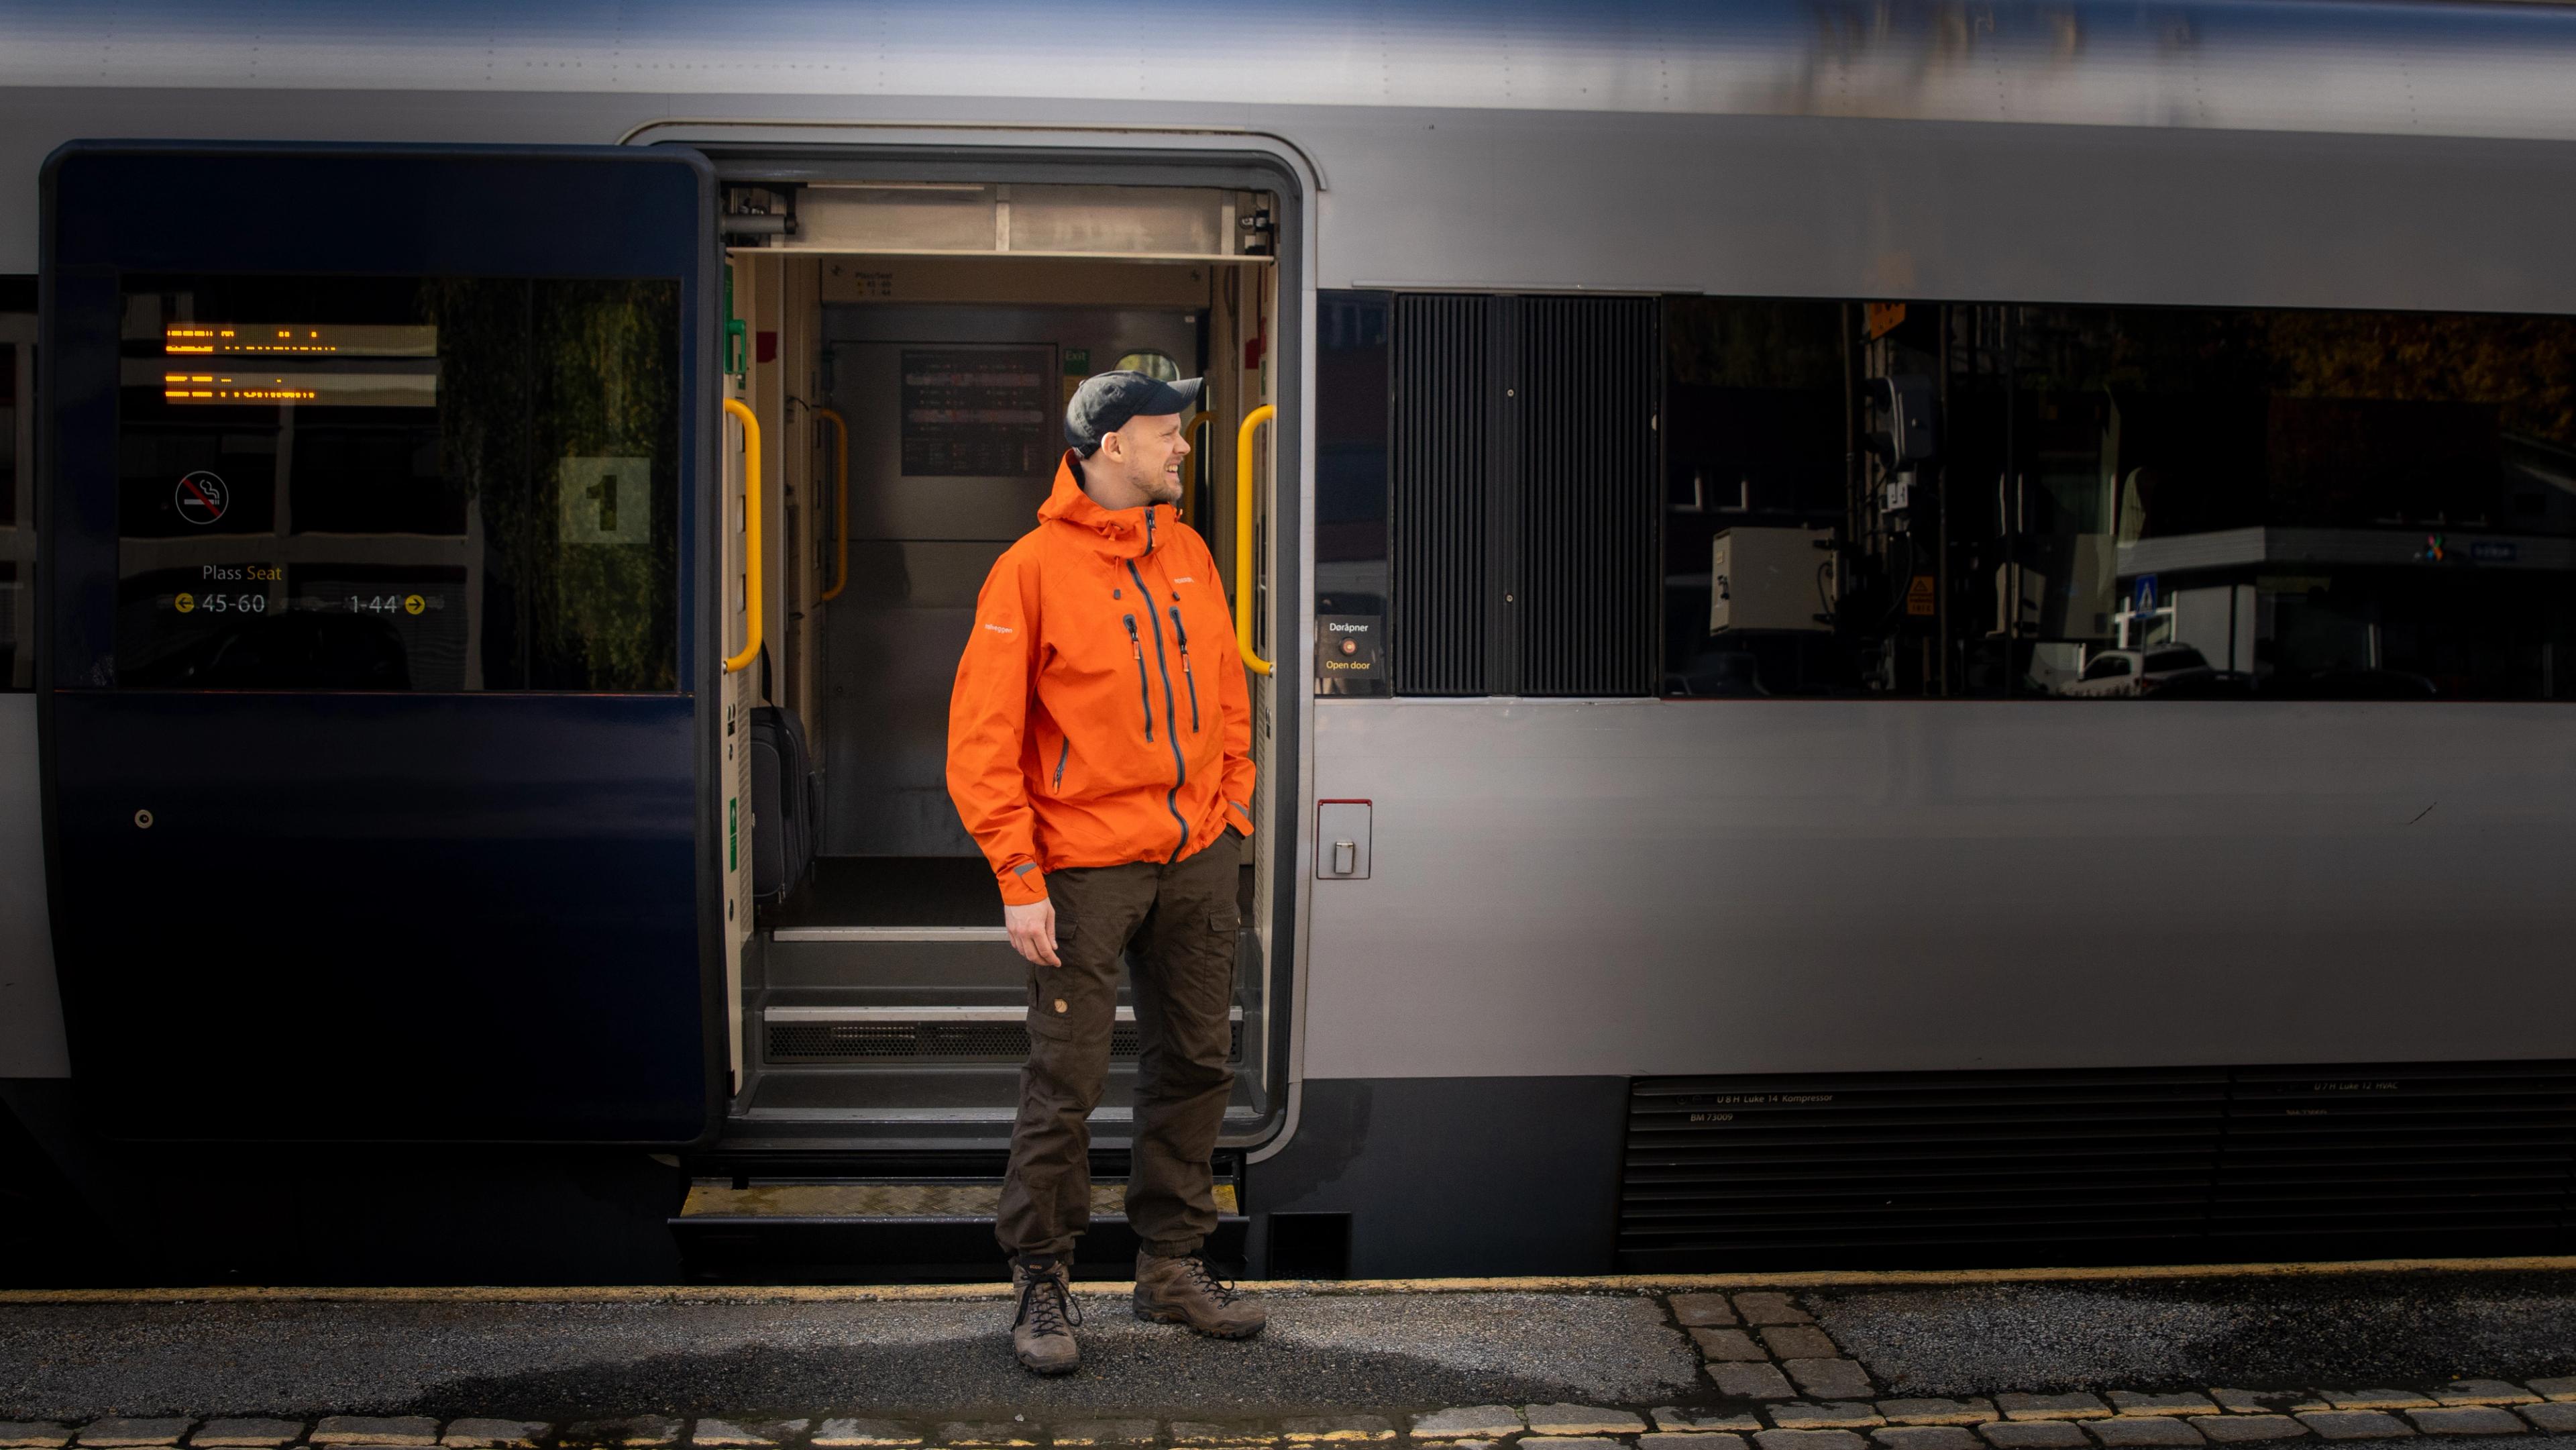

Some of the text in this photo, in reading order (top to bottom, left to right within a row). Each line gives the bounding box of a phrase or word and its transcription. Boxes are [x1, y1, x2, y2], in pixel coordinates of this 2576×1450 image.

[1065, 350, 1085, 360] Exit
[586, 474, 617, 531] 1
[203, 565, 282, 580] Plass Seat
[203, 594, 265, 612] 45-60
[351, 595, 397, 613] 1-44
[1330, 623, 1368, 633] Døråpner
[1326, 660, 1371, 670] Open door
[2339, 1082, 2359, 1090] Luke
[2362, 1082, 2371, 1090] 12
[2375, 1081, 2399, 1089] HVAC
[1743, 1094, 1765, 1103] Luke
[1782, 1094, 1833, 1103] Kompressor
[1690, 1113, 1733, 1122] BM 73009
